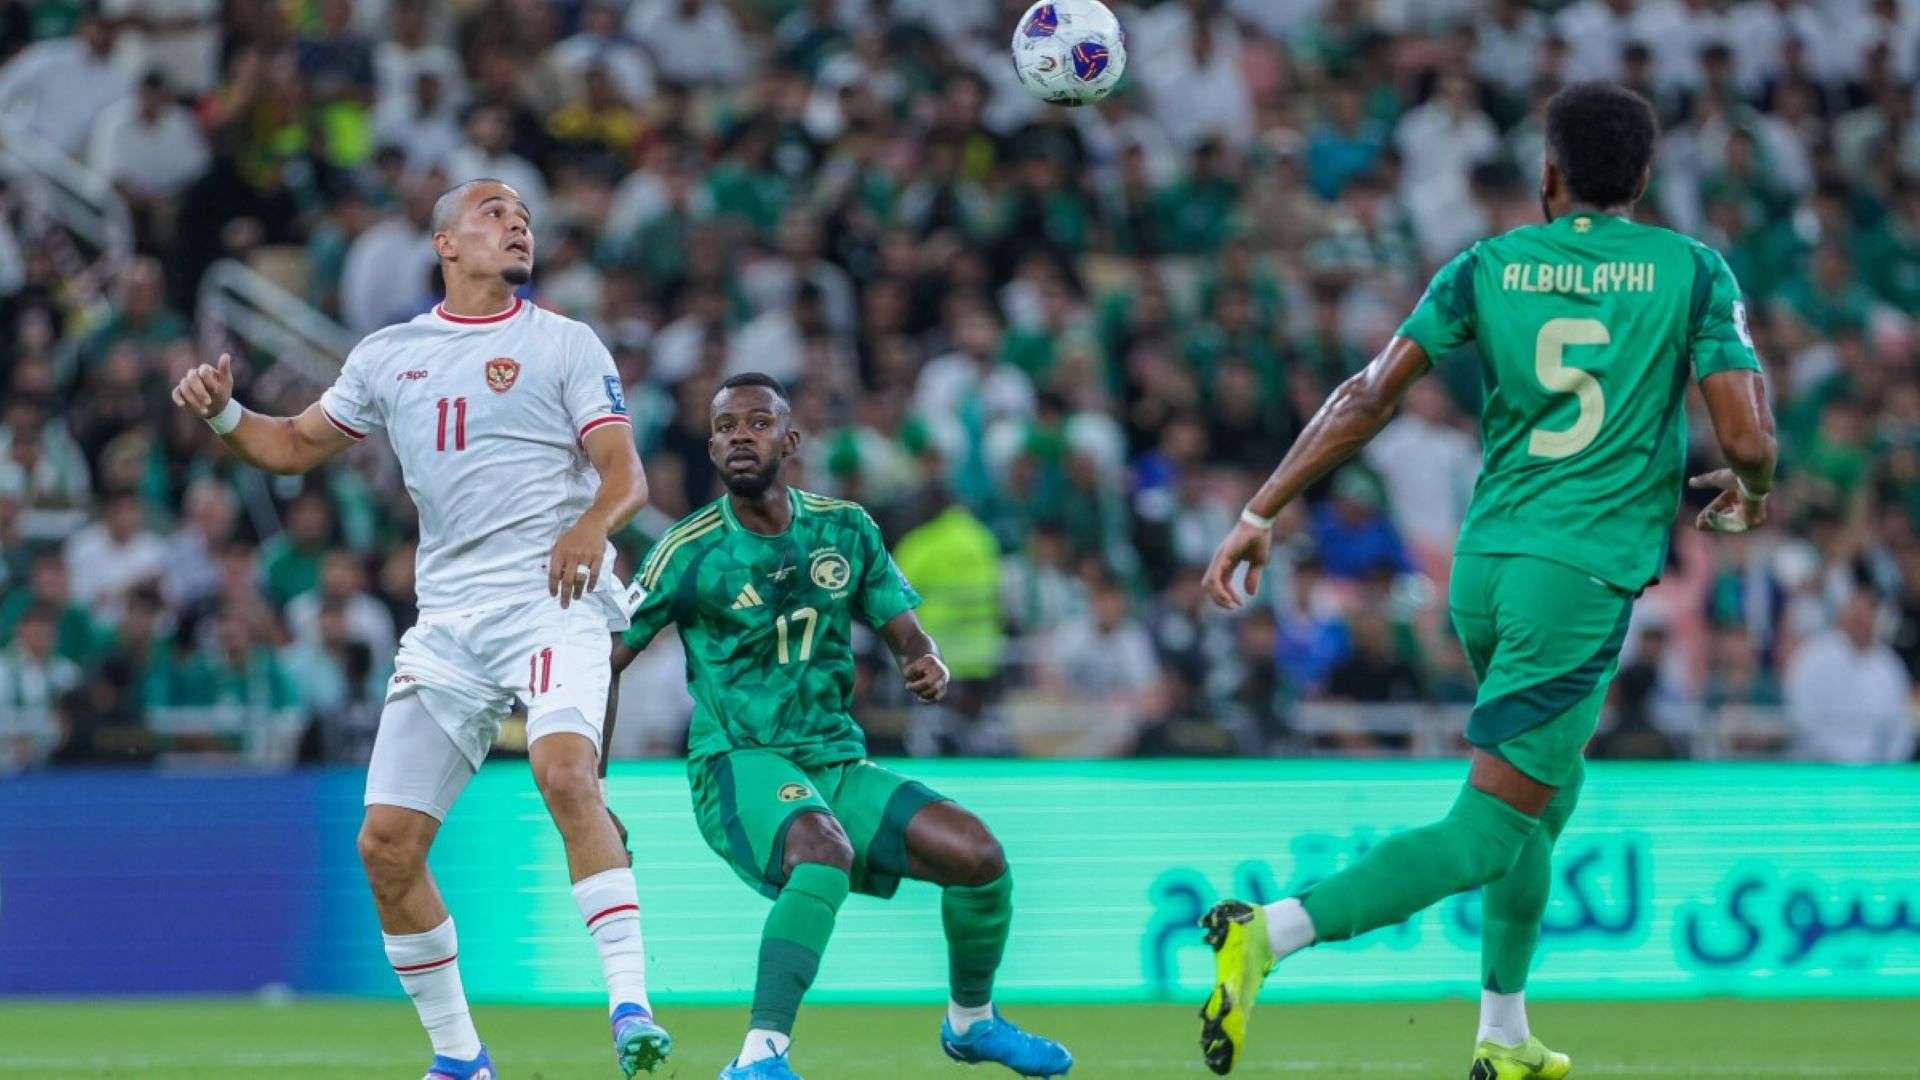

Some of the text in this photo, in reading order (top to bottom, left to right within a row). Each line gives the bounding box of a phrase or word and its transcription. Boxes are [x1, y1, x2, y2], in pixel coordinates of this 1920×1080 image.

[1502, 262, 1655, 293] ALBULAYHI
[1527, 317, 1611, 459] 5
[436, 397, 467, 451] 11
[776, 607, 818, 665] 17
[528, 647, 553, 697] 11
